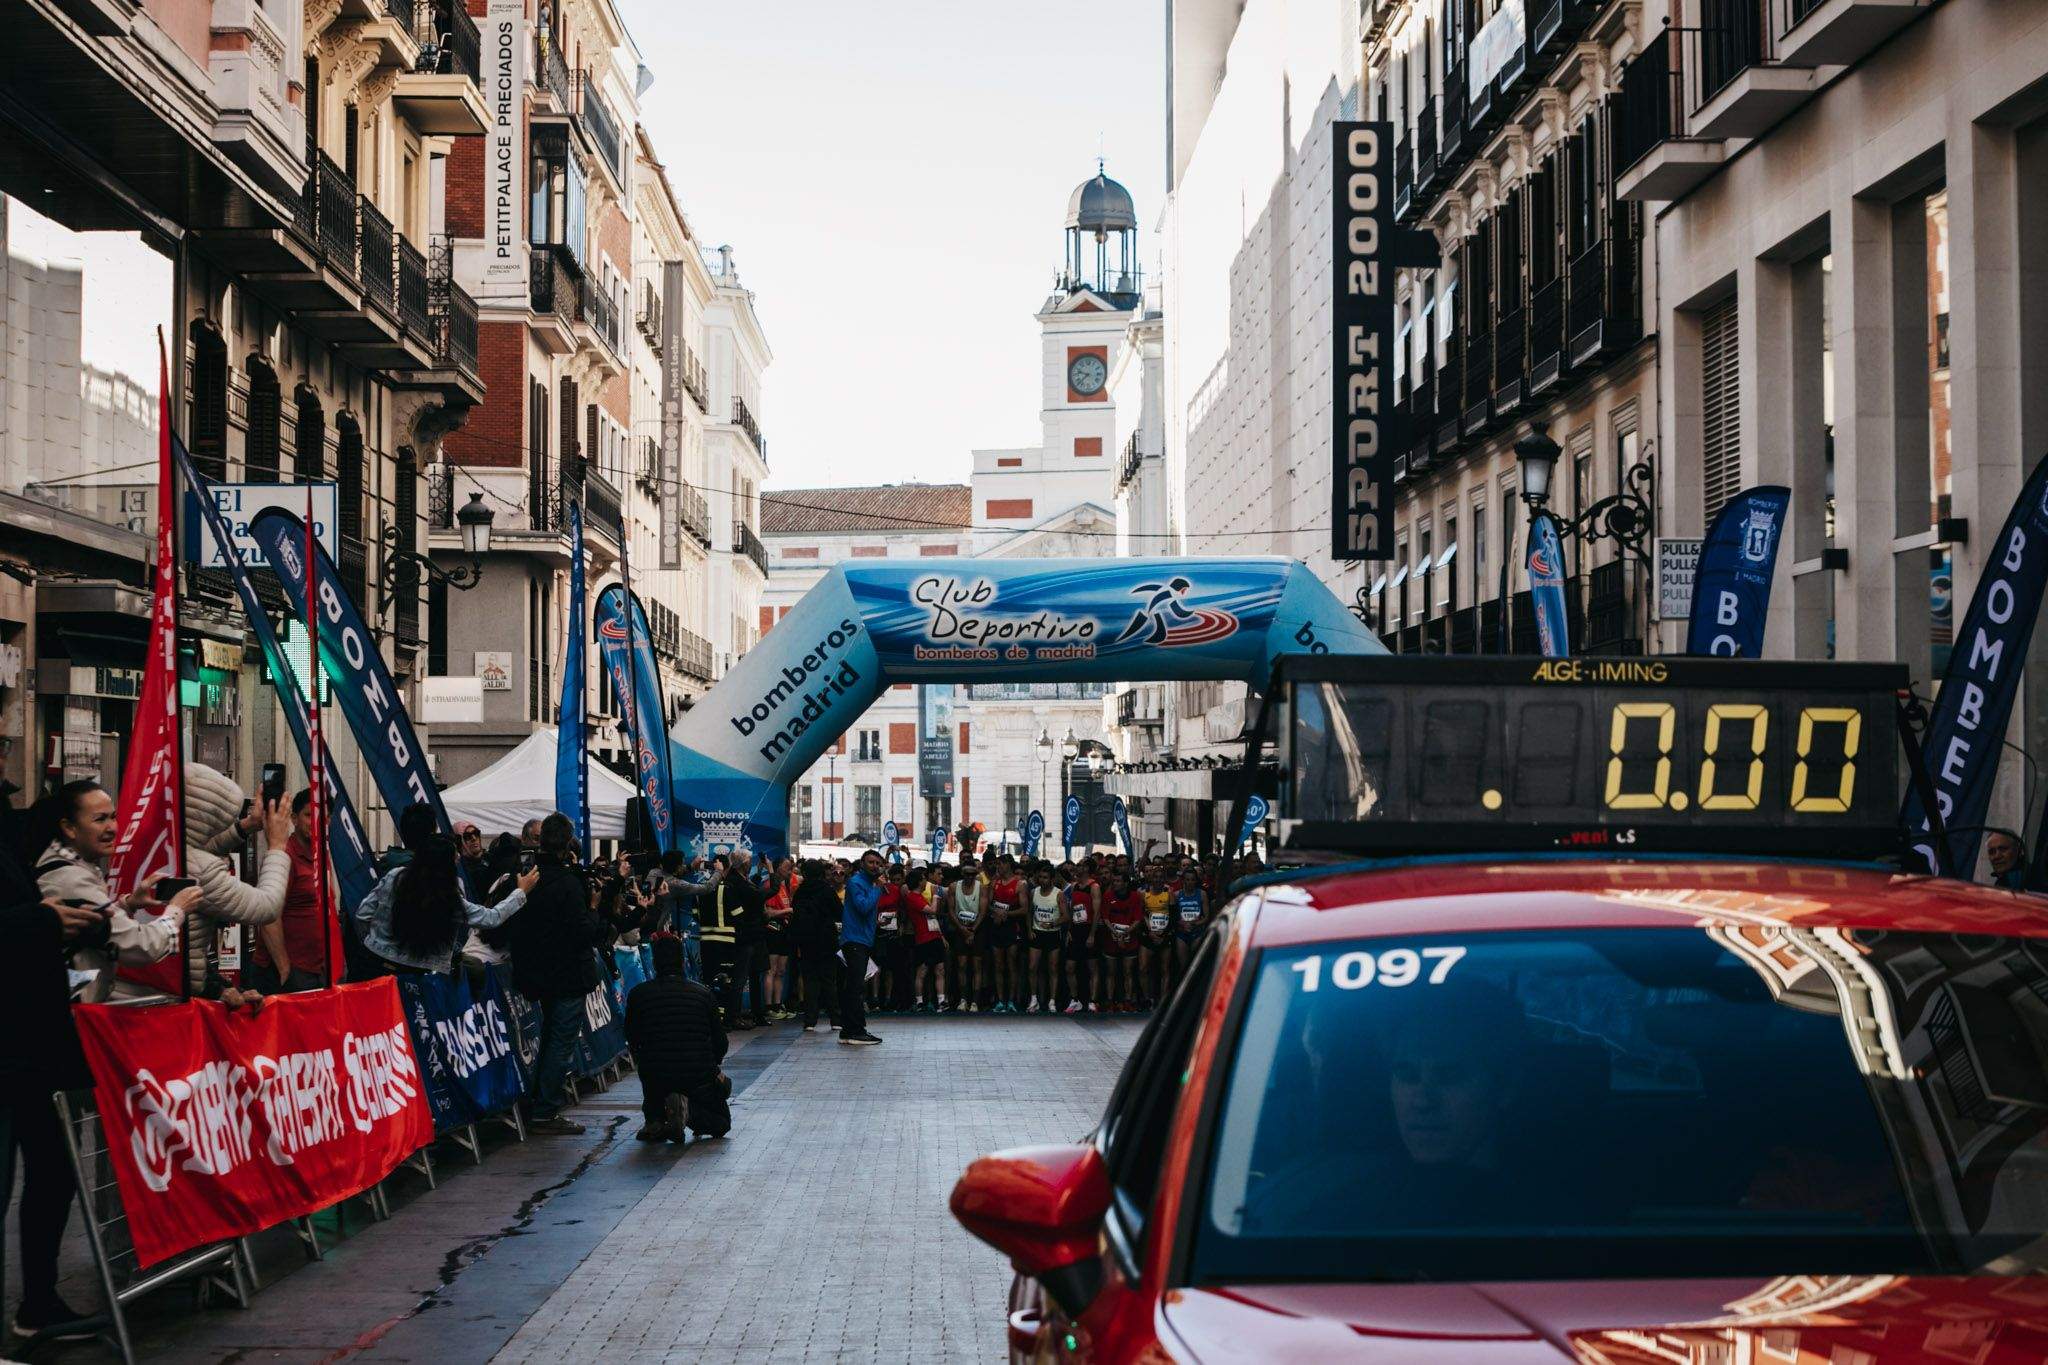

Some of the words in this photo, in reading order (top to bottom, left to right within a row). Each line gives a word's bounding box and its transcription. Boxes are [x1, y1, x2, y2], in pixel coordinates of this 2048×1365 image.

[1348, 129, 1379, 296] 2000
[669, 334, 678, 365] Locker
[670, 367, 678, 387] Foot
[1348, 325, 1379, 552] SPORT
[213, 489, 241, 512] El
[212, 547, 267, 564] Azu
[916, 578, 992, 605] Club
[931, 602, 1095, 647] Deportivo
[916, 646, 998, 660] bomberos
[1007, 645, 1027, 660] de
[1038, 643, 1095, 659] madrid
[730, 618, 858, 737] bomberos
[1533, 661, 1668, 682] ALGE-IMING
[431, 695, 481, 703] STRADIVARIUS
[760, 660, 861, 763] madrid
[694, 809, 750, 819] bomberos
[1292, 946, 1467, 992] 1097
